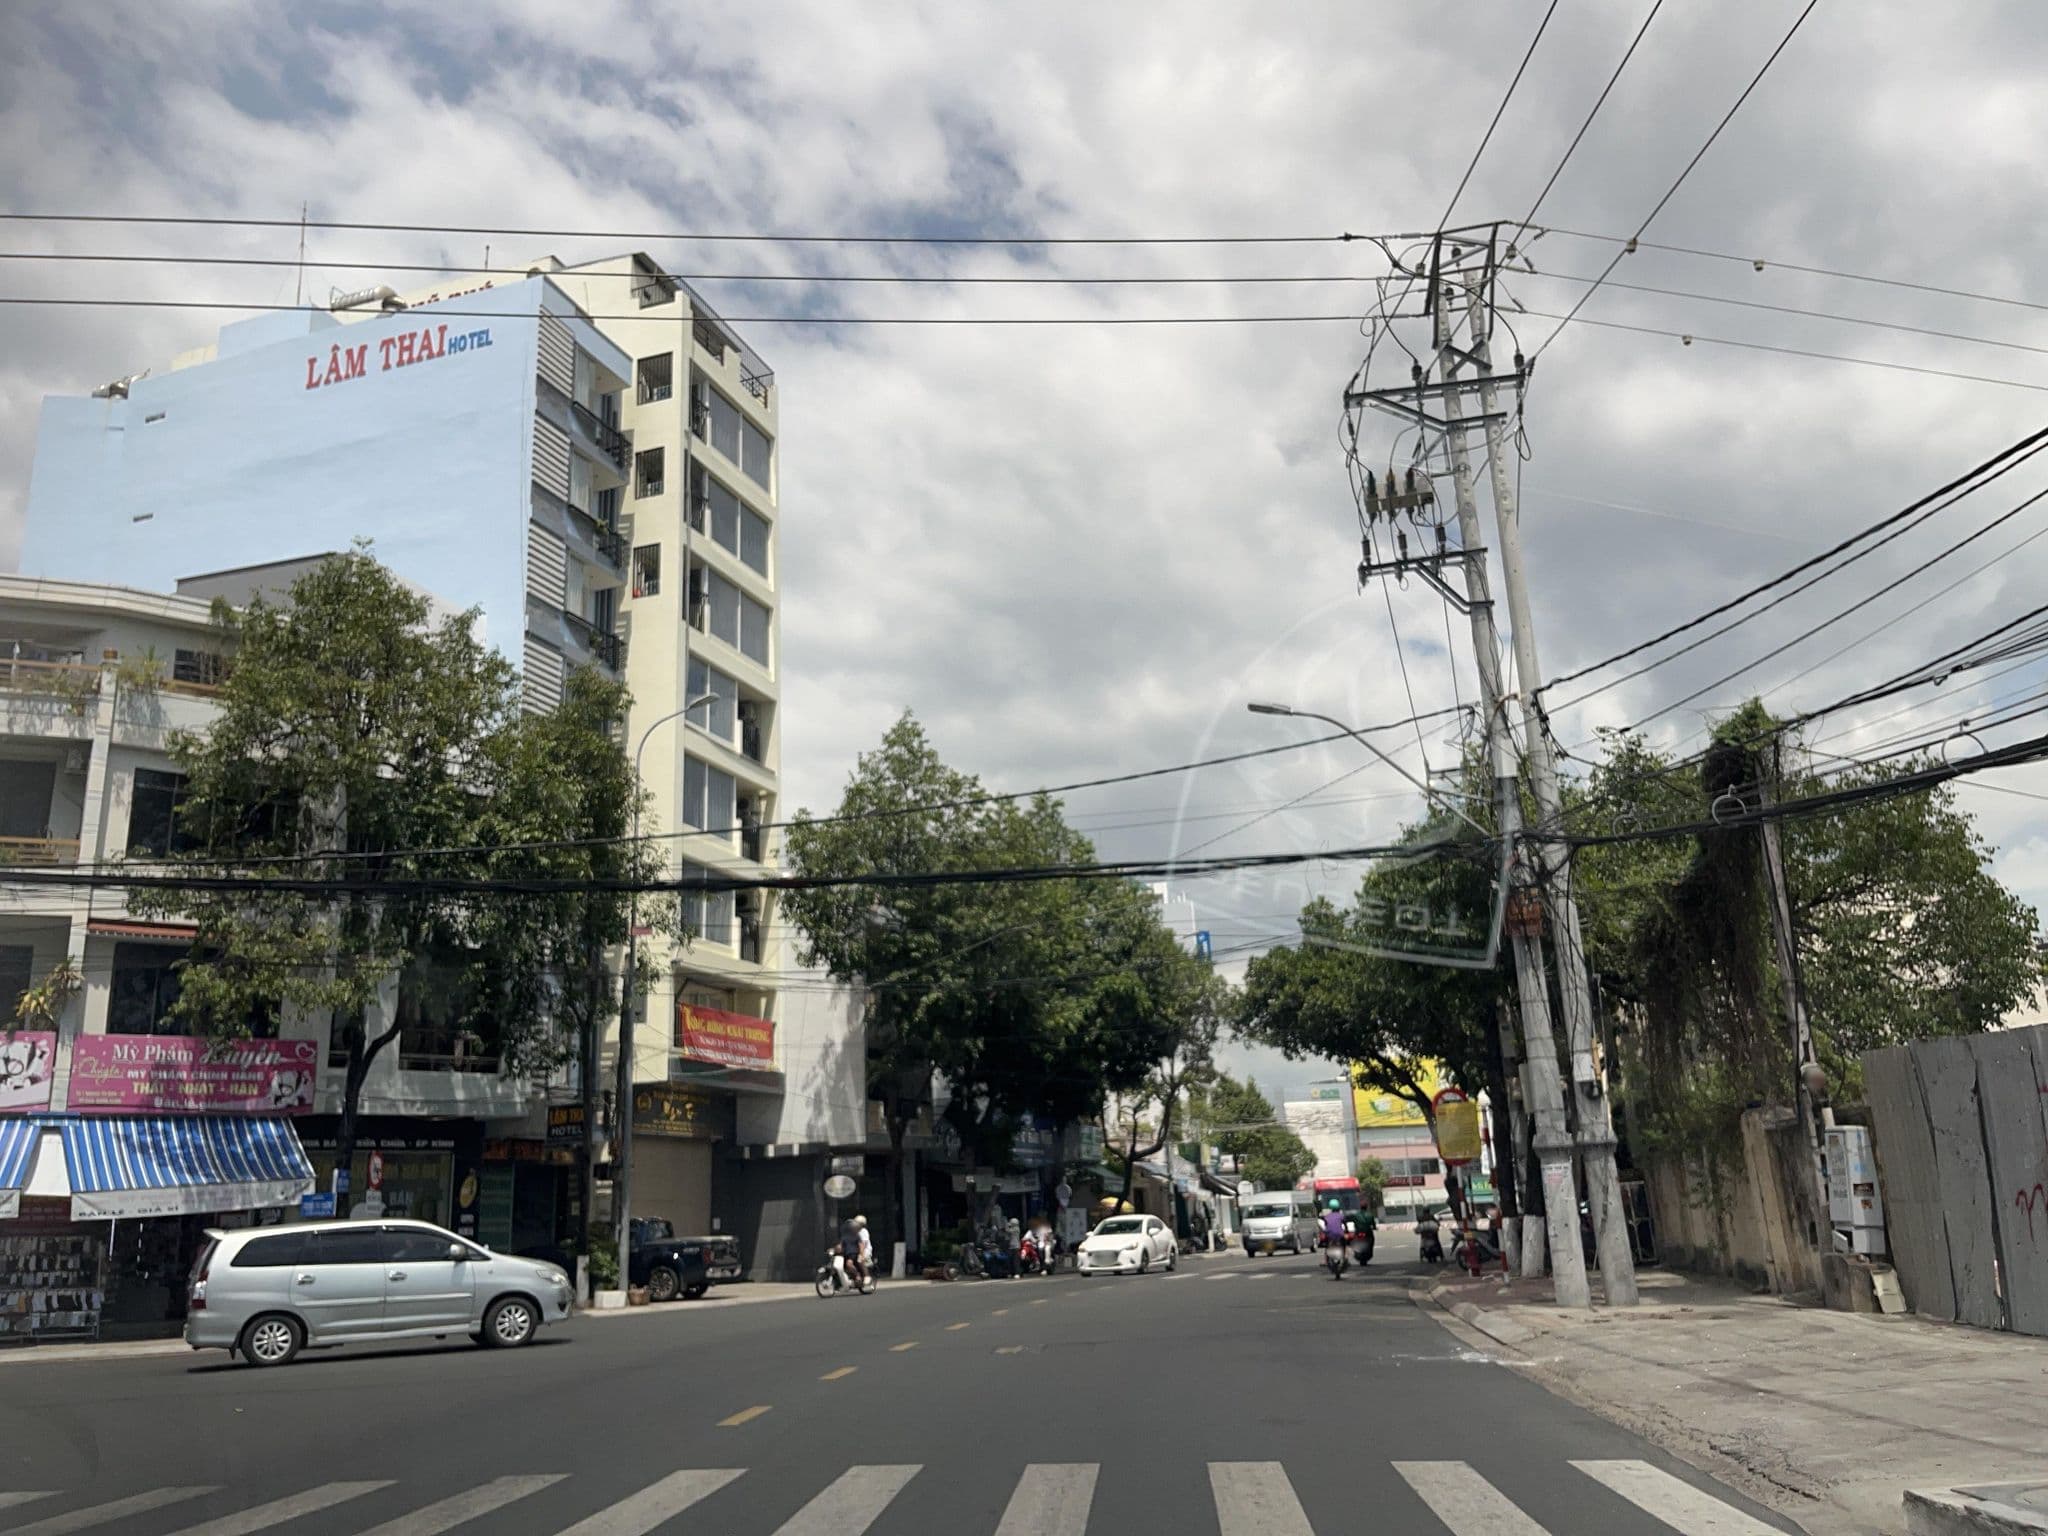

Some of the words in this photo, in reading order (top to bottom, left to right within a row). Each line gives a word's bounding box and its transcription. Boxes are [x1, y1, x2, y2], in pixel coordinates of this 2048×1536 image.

[305, 343, 369, 390] LÂM
[379, 323, 448, 371] THAI
[448, 327, 493, 356] HOTEL
